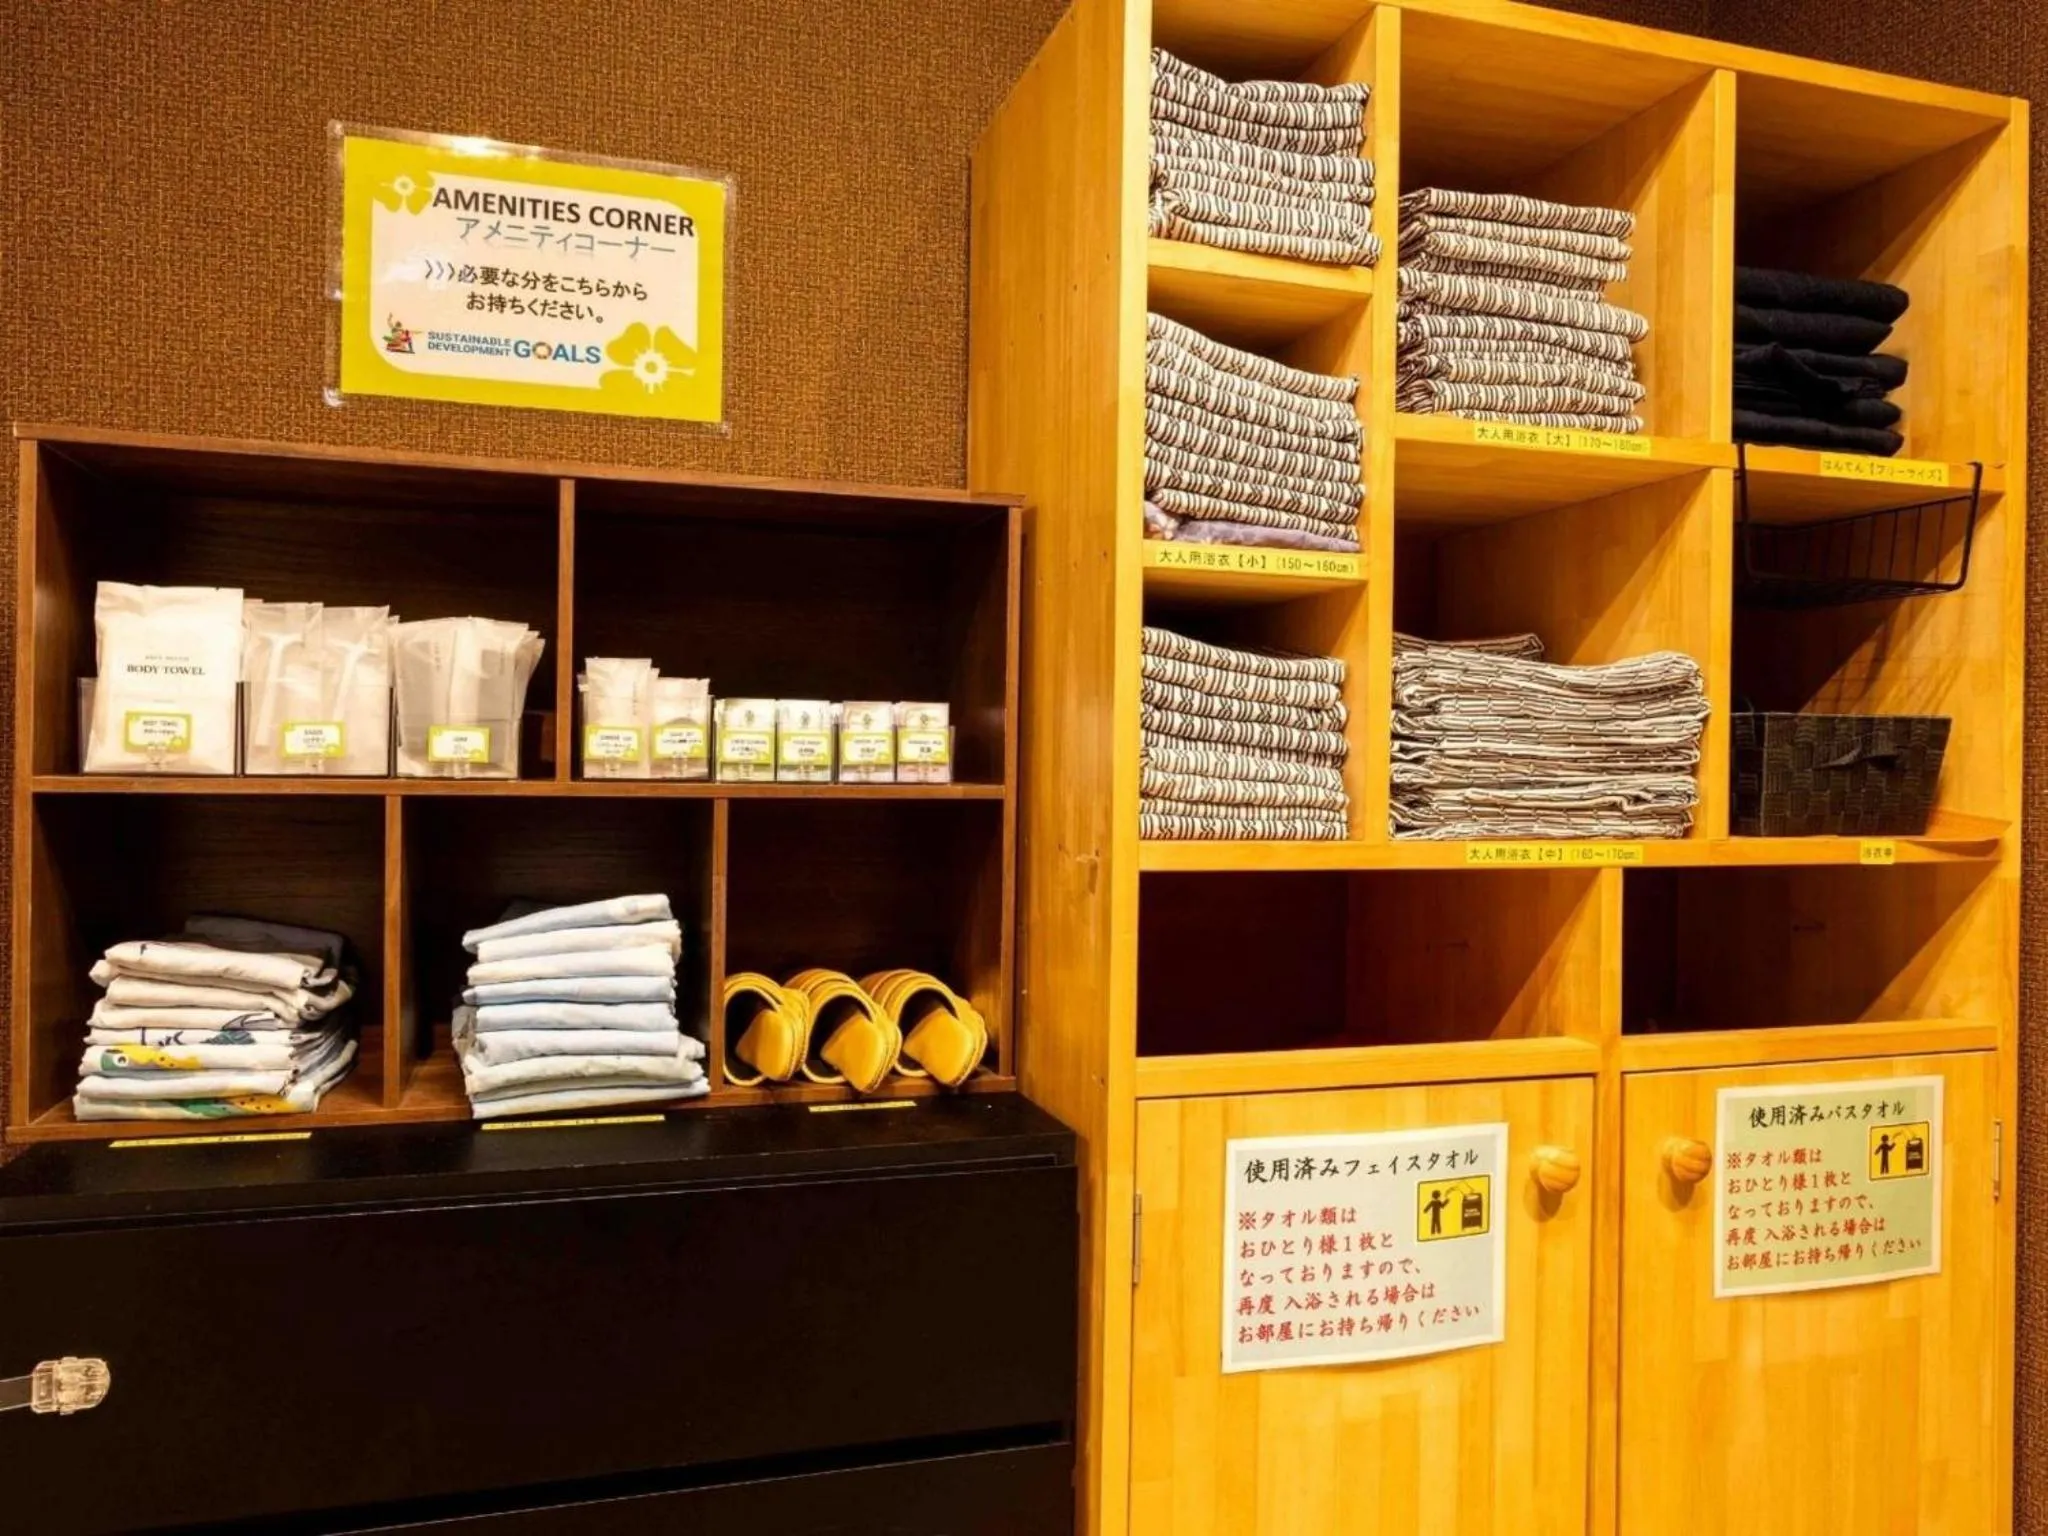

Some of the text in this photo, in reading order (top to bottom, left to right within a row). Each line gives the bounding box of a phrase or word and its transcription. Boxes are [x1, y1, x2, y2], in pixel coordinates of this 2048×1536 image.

[432, 186, 695, 237] AMENITIES CORNER
[456, 217, 676, 259] アメニティコーナー
[466, 291, 604, 324] お持ちください。
[427, 331, 512, 347] SUSTAINABLE
[427, 341, 512, 357] DEVELOPMENT
[513, 339, 602, 364] GOALS
[127, 664, 206, 676] BODY TOWEL
[1749, 1099, 1906, 1129] 使用済みバスタオル
[1244, 1148, 1480, 1185] 使用済みフェイスタオル
[1726, 1147, 1823, 1170] ※タオル類は
[1727, 1170, 1852, 1195] おひとり様1枚と
[1238, 1205, 1358, 1231] ※タオル類は
[1728, 1194, 1875, 1221] なっておりますので、
[1240, 1232, 1395, 1259] おひとり様1枚と
[1726, 1237, 1922, 1271] お部屋にお持ち帰りください
[1240, 1257, 1422, 1287] なっておりますので、
[1238, 1304, 1481, 1345] お部屋にお持ち帰りください
